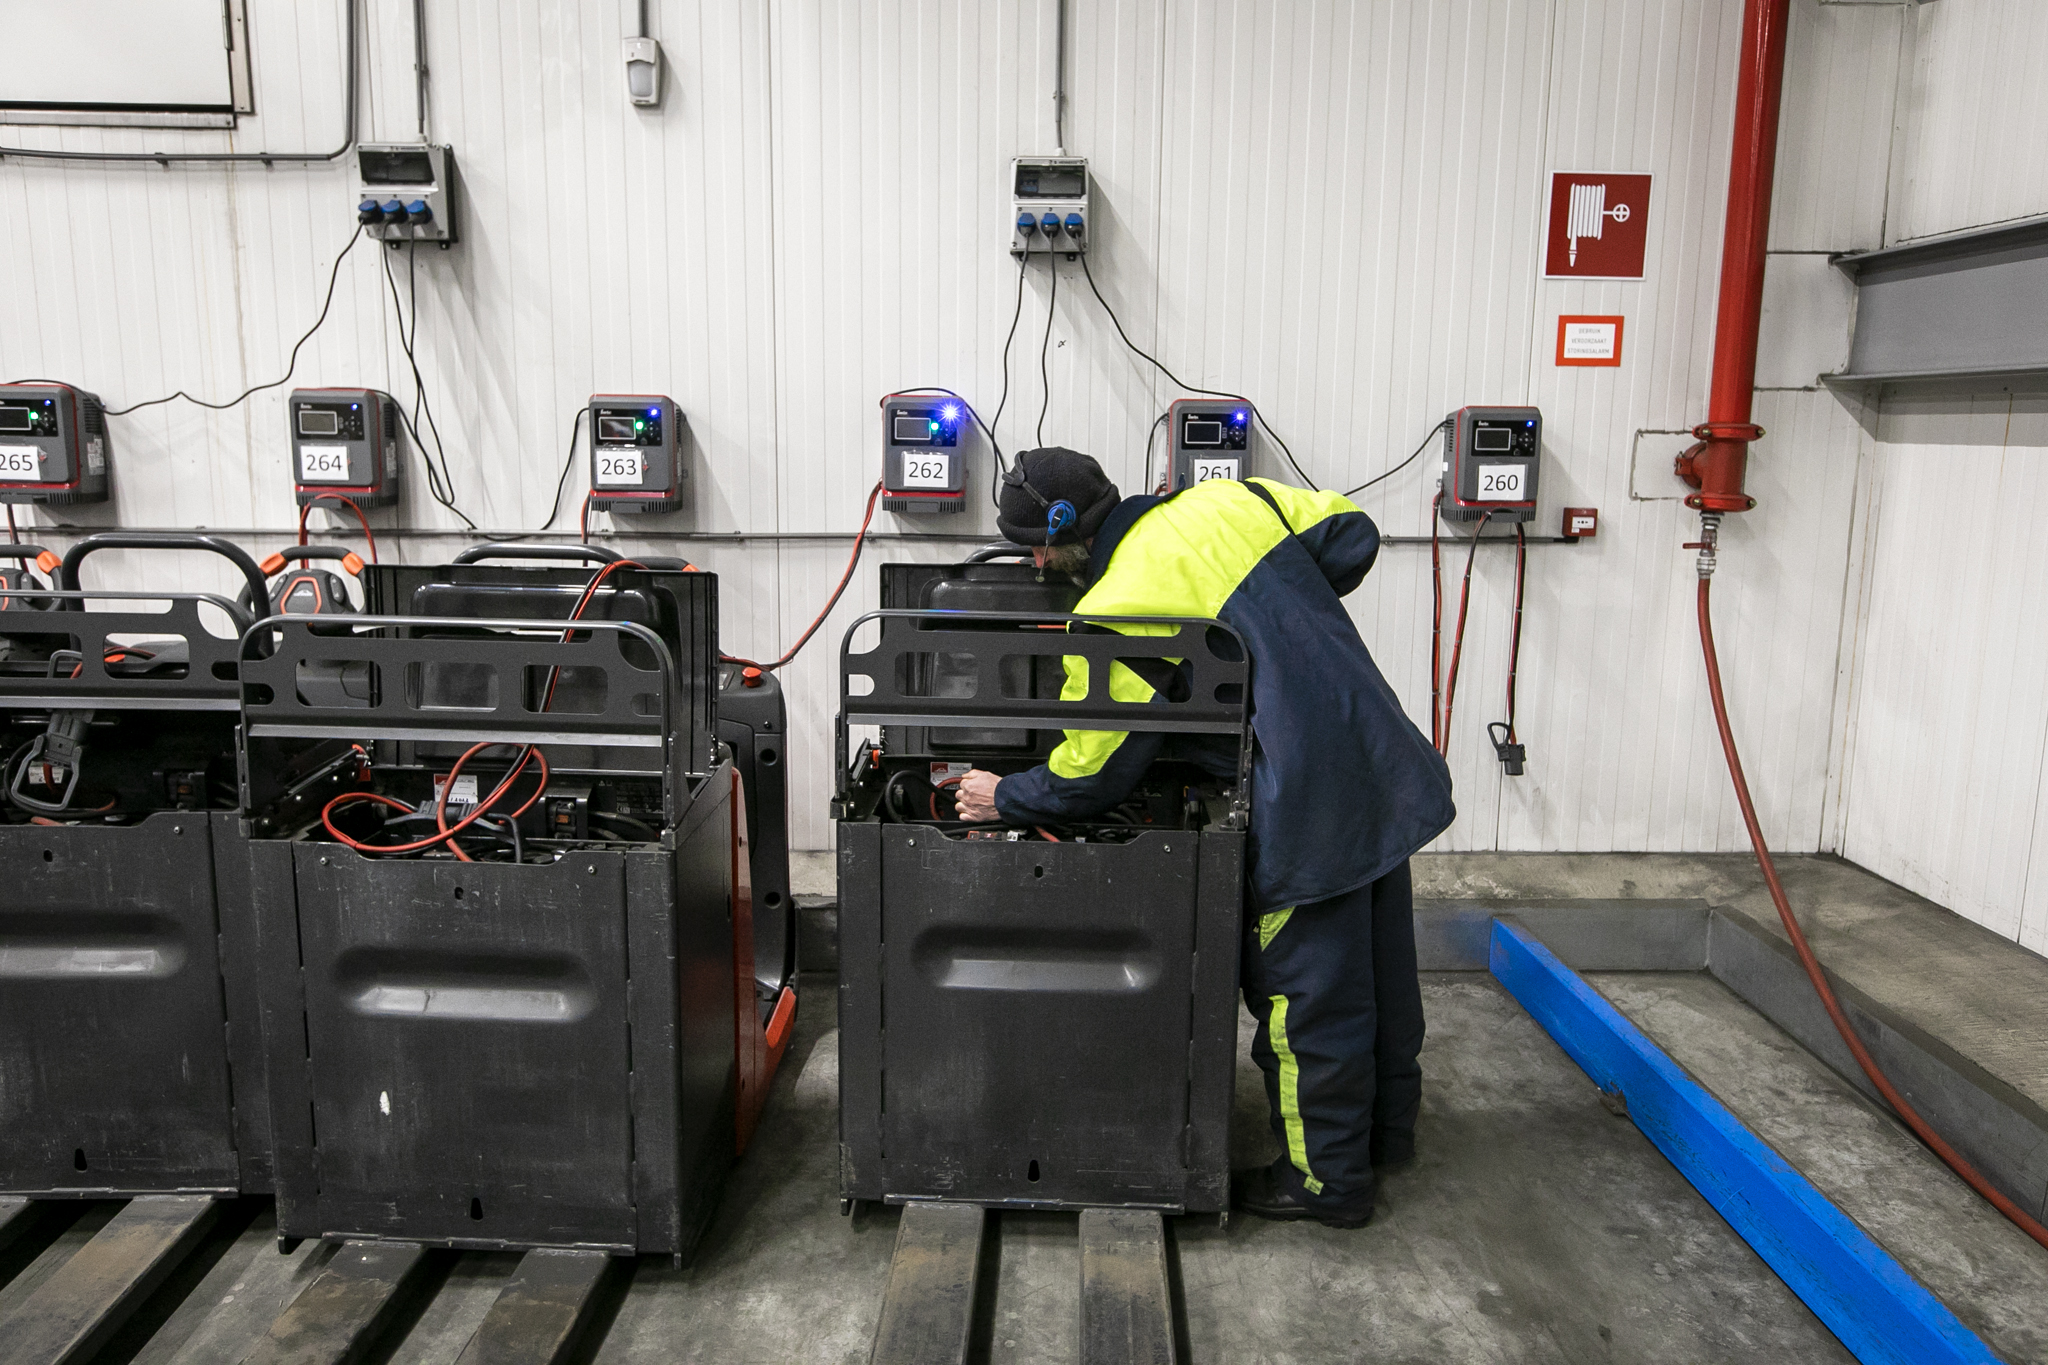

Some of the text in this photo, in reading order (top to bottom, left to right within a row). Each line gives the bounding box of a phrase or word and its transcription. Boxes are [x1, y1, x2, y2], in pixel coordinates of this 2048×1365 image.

[0, 454, 33, 471] 265
[306, 454, 343, 471] 264
[601, 458, 637, 476] 263
[908, 461, 944, 479] 262
[1199, 466, 1231, 482] 261
[1483, 474, 1519, 491] 260
